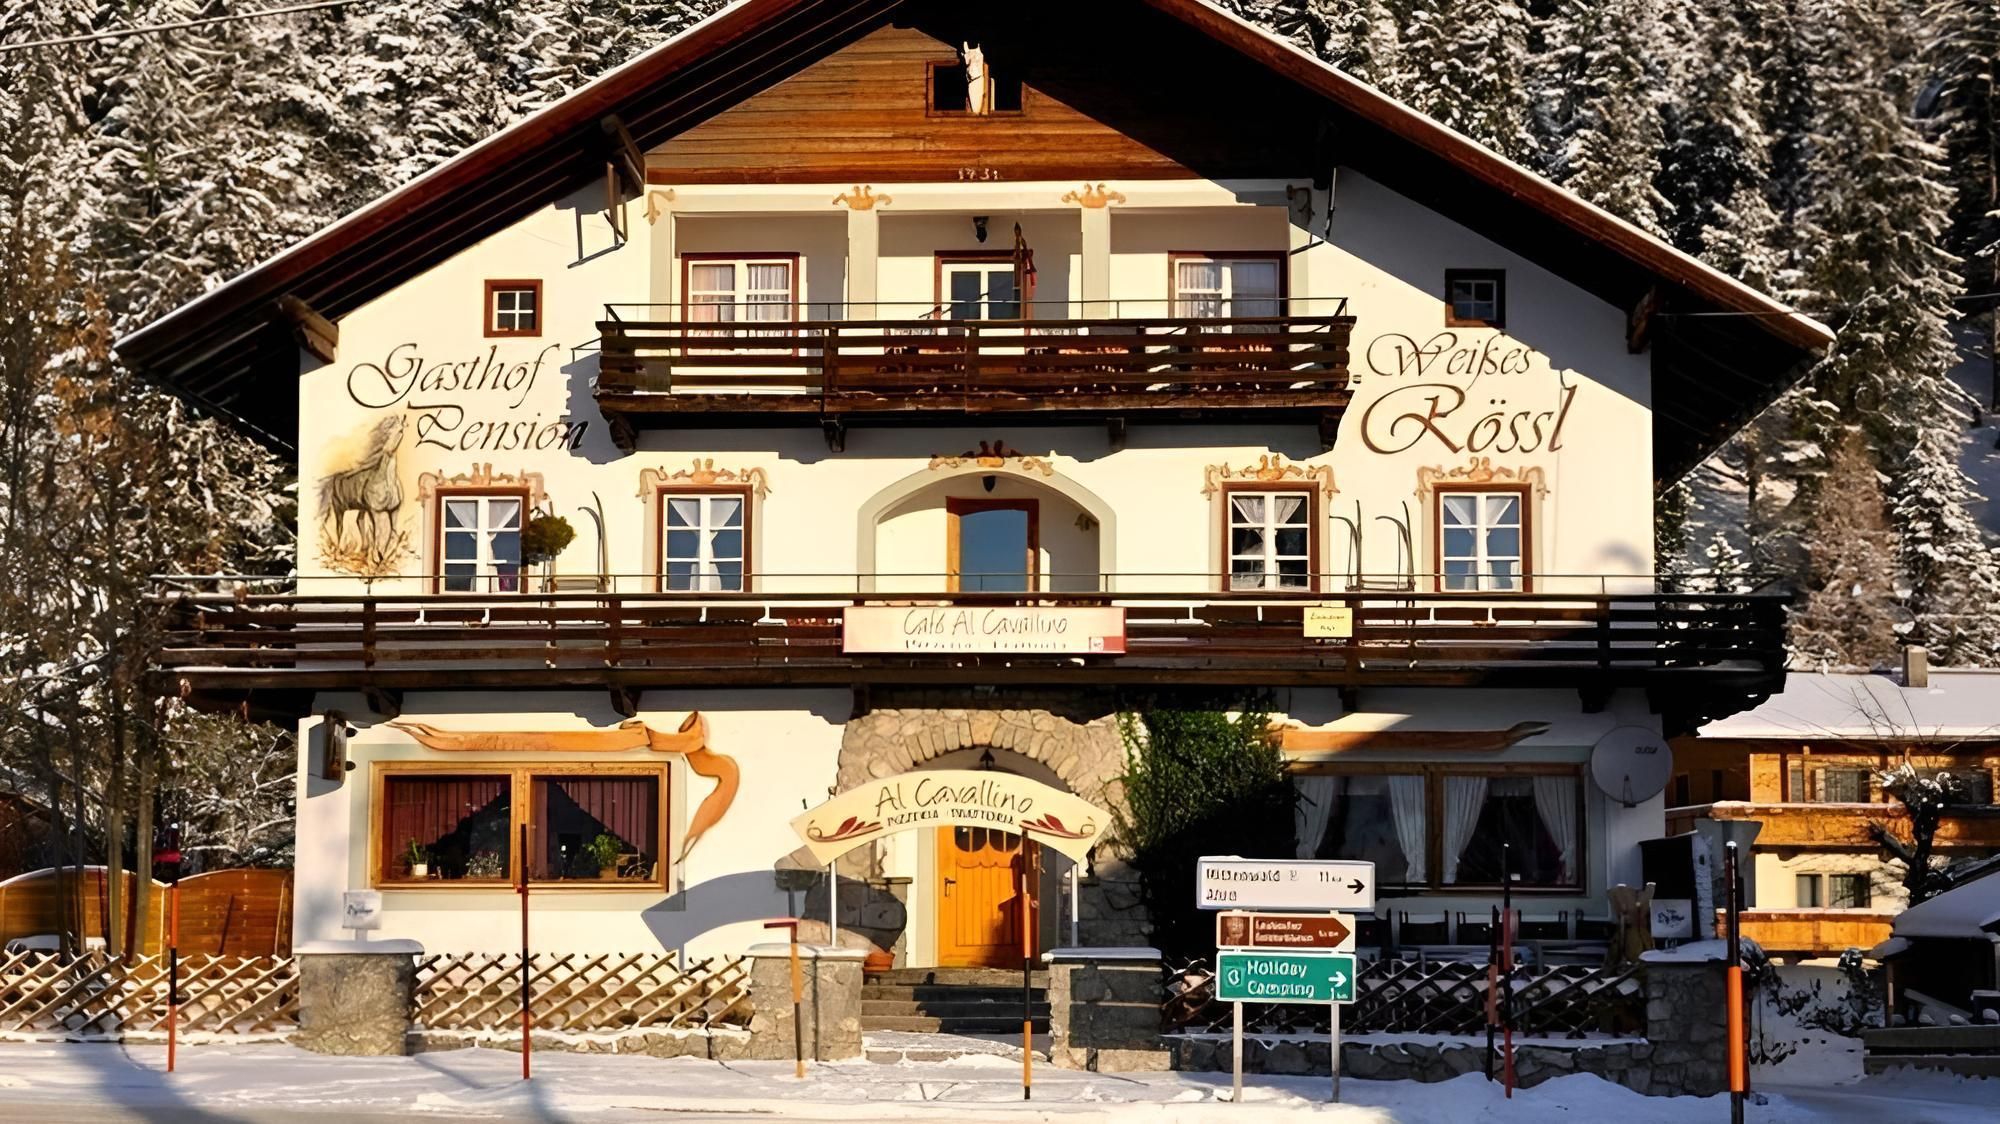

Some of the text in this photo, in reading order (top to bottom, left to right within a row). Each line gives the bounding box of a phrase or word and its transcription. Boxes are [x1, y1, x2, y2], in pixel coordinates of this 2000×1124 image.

[347, 343, 560, 409] Gasthof
[1366, 331, 1536, 391] Weißes
[407, 400, 589, 451] Pension
[1360, 383, 1578, 454] Rössl
[875, 778, 1033, 817] Al Cavallino
